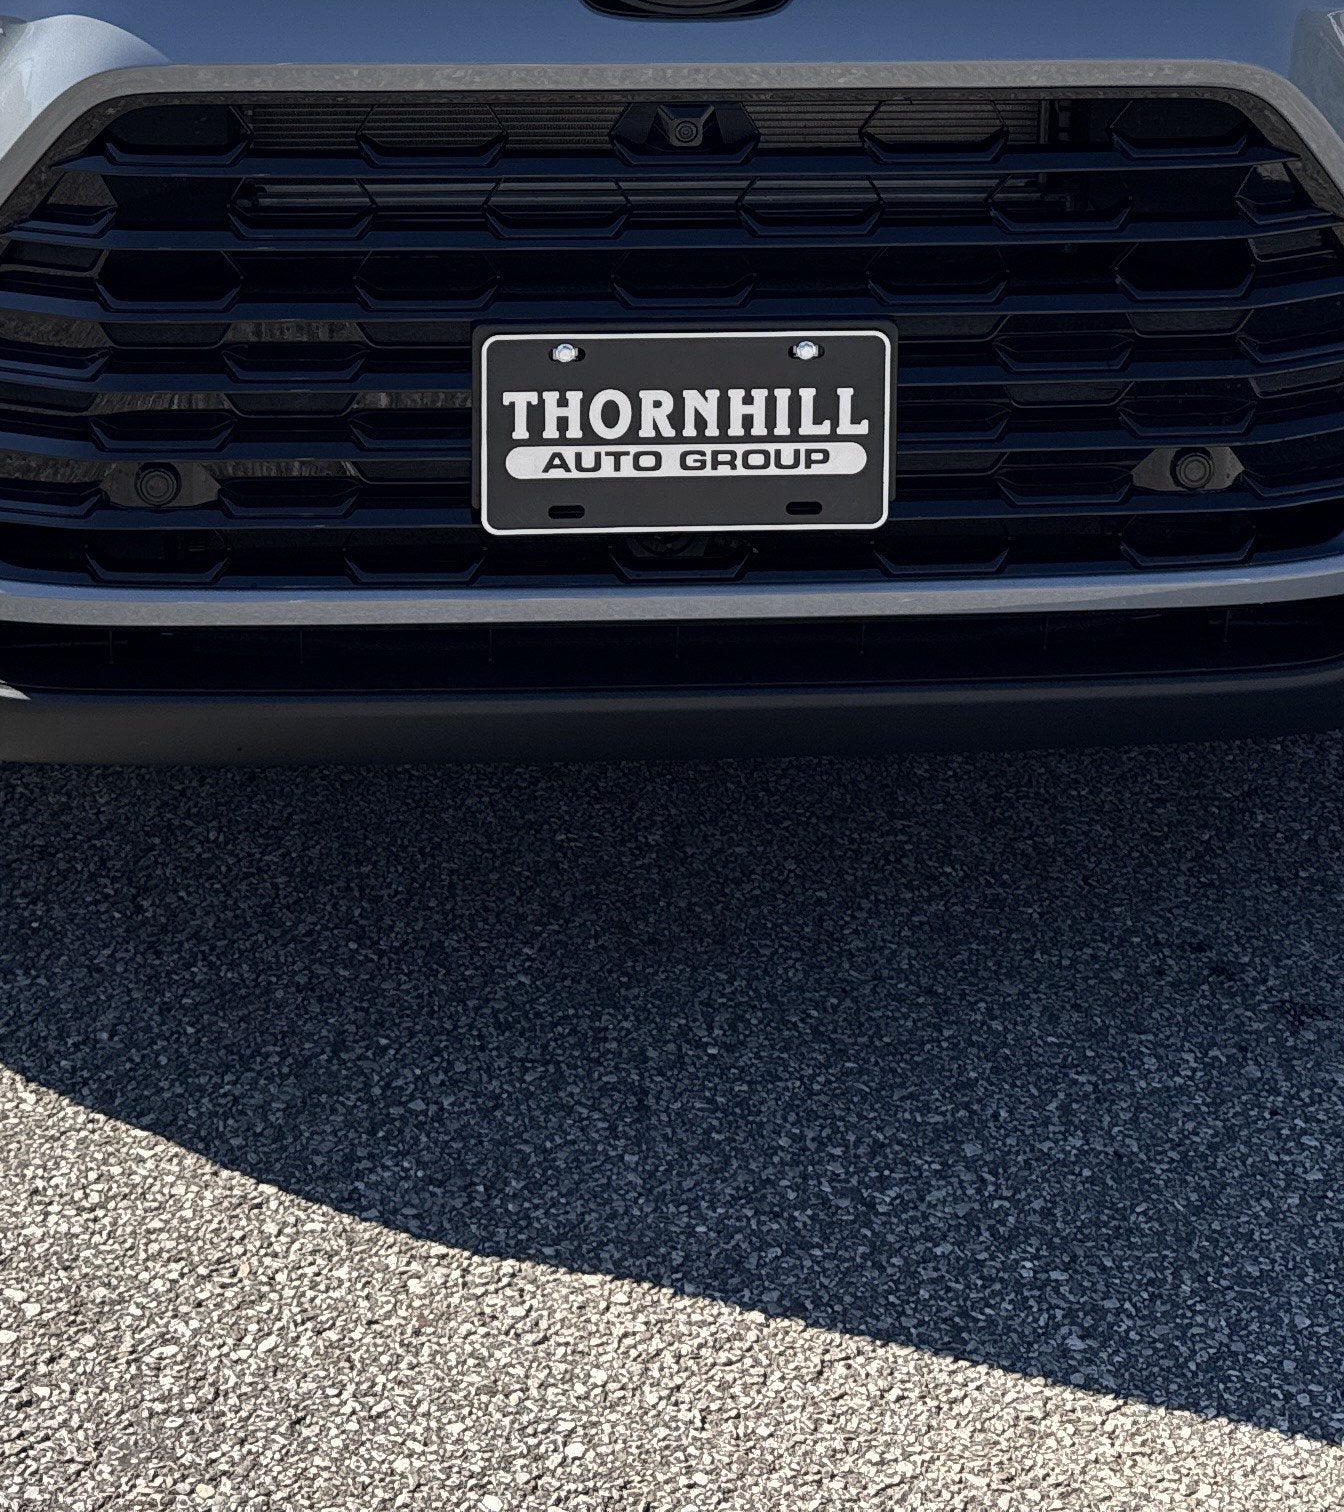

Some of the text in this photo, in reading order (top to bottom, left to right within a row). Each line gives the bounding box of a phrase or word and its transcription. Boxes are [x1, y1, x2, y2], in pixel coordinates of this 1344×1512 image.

[502, 387, 869, 440] THORNHILL
[541, 448, 830, 473] AUTO GROUP
